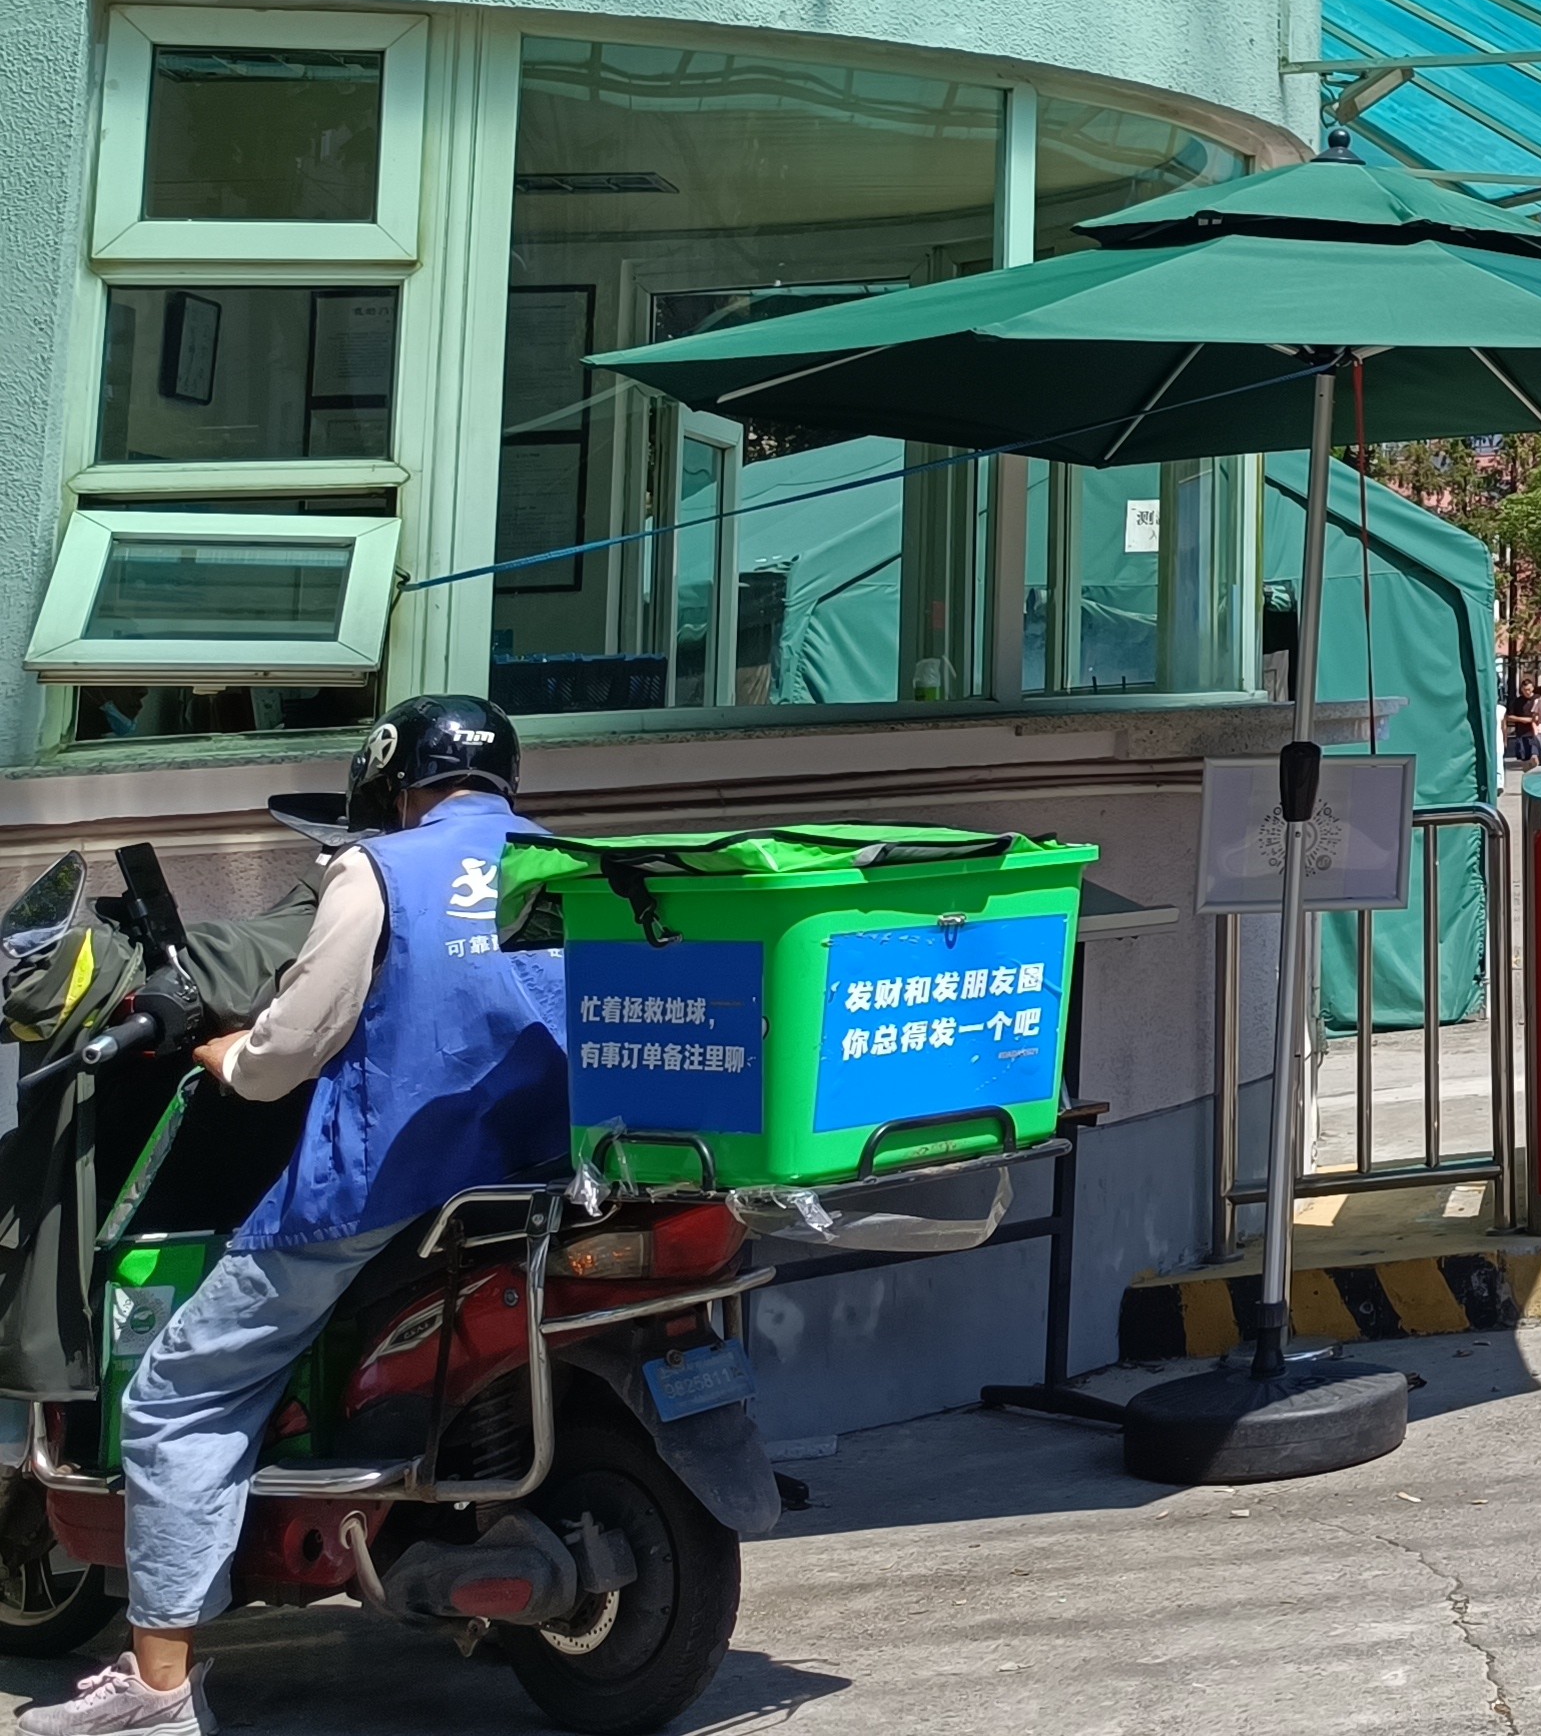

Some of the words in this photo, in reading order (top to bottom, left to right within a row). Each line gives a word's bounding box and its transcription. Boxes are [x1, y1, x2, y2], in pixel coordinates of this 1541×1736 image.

[844, 963, 1044, 1013] 发财和发朋友圈
[580, 1041, 745, 1073] 有事订单备注里聊
[841, 1007, 1042, 1061] 你总得发一个吧
